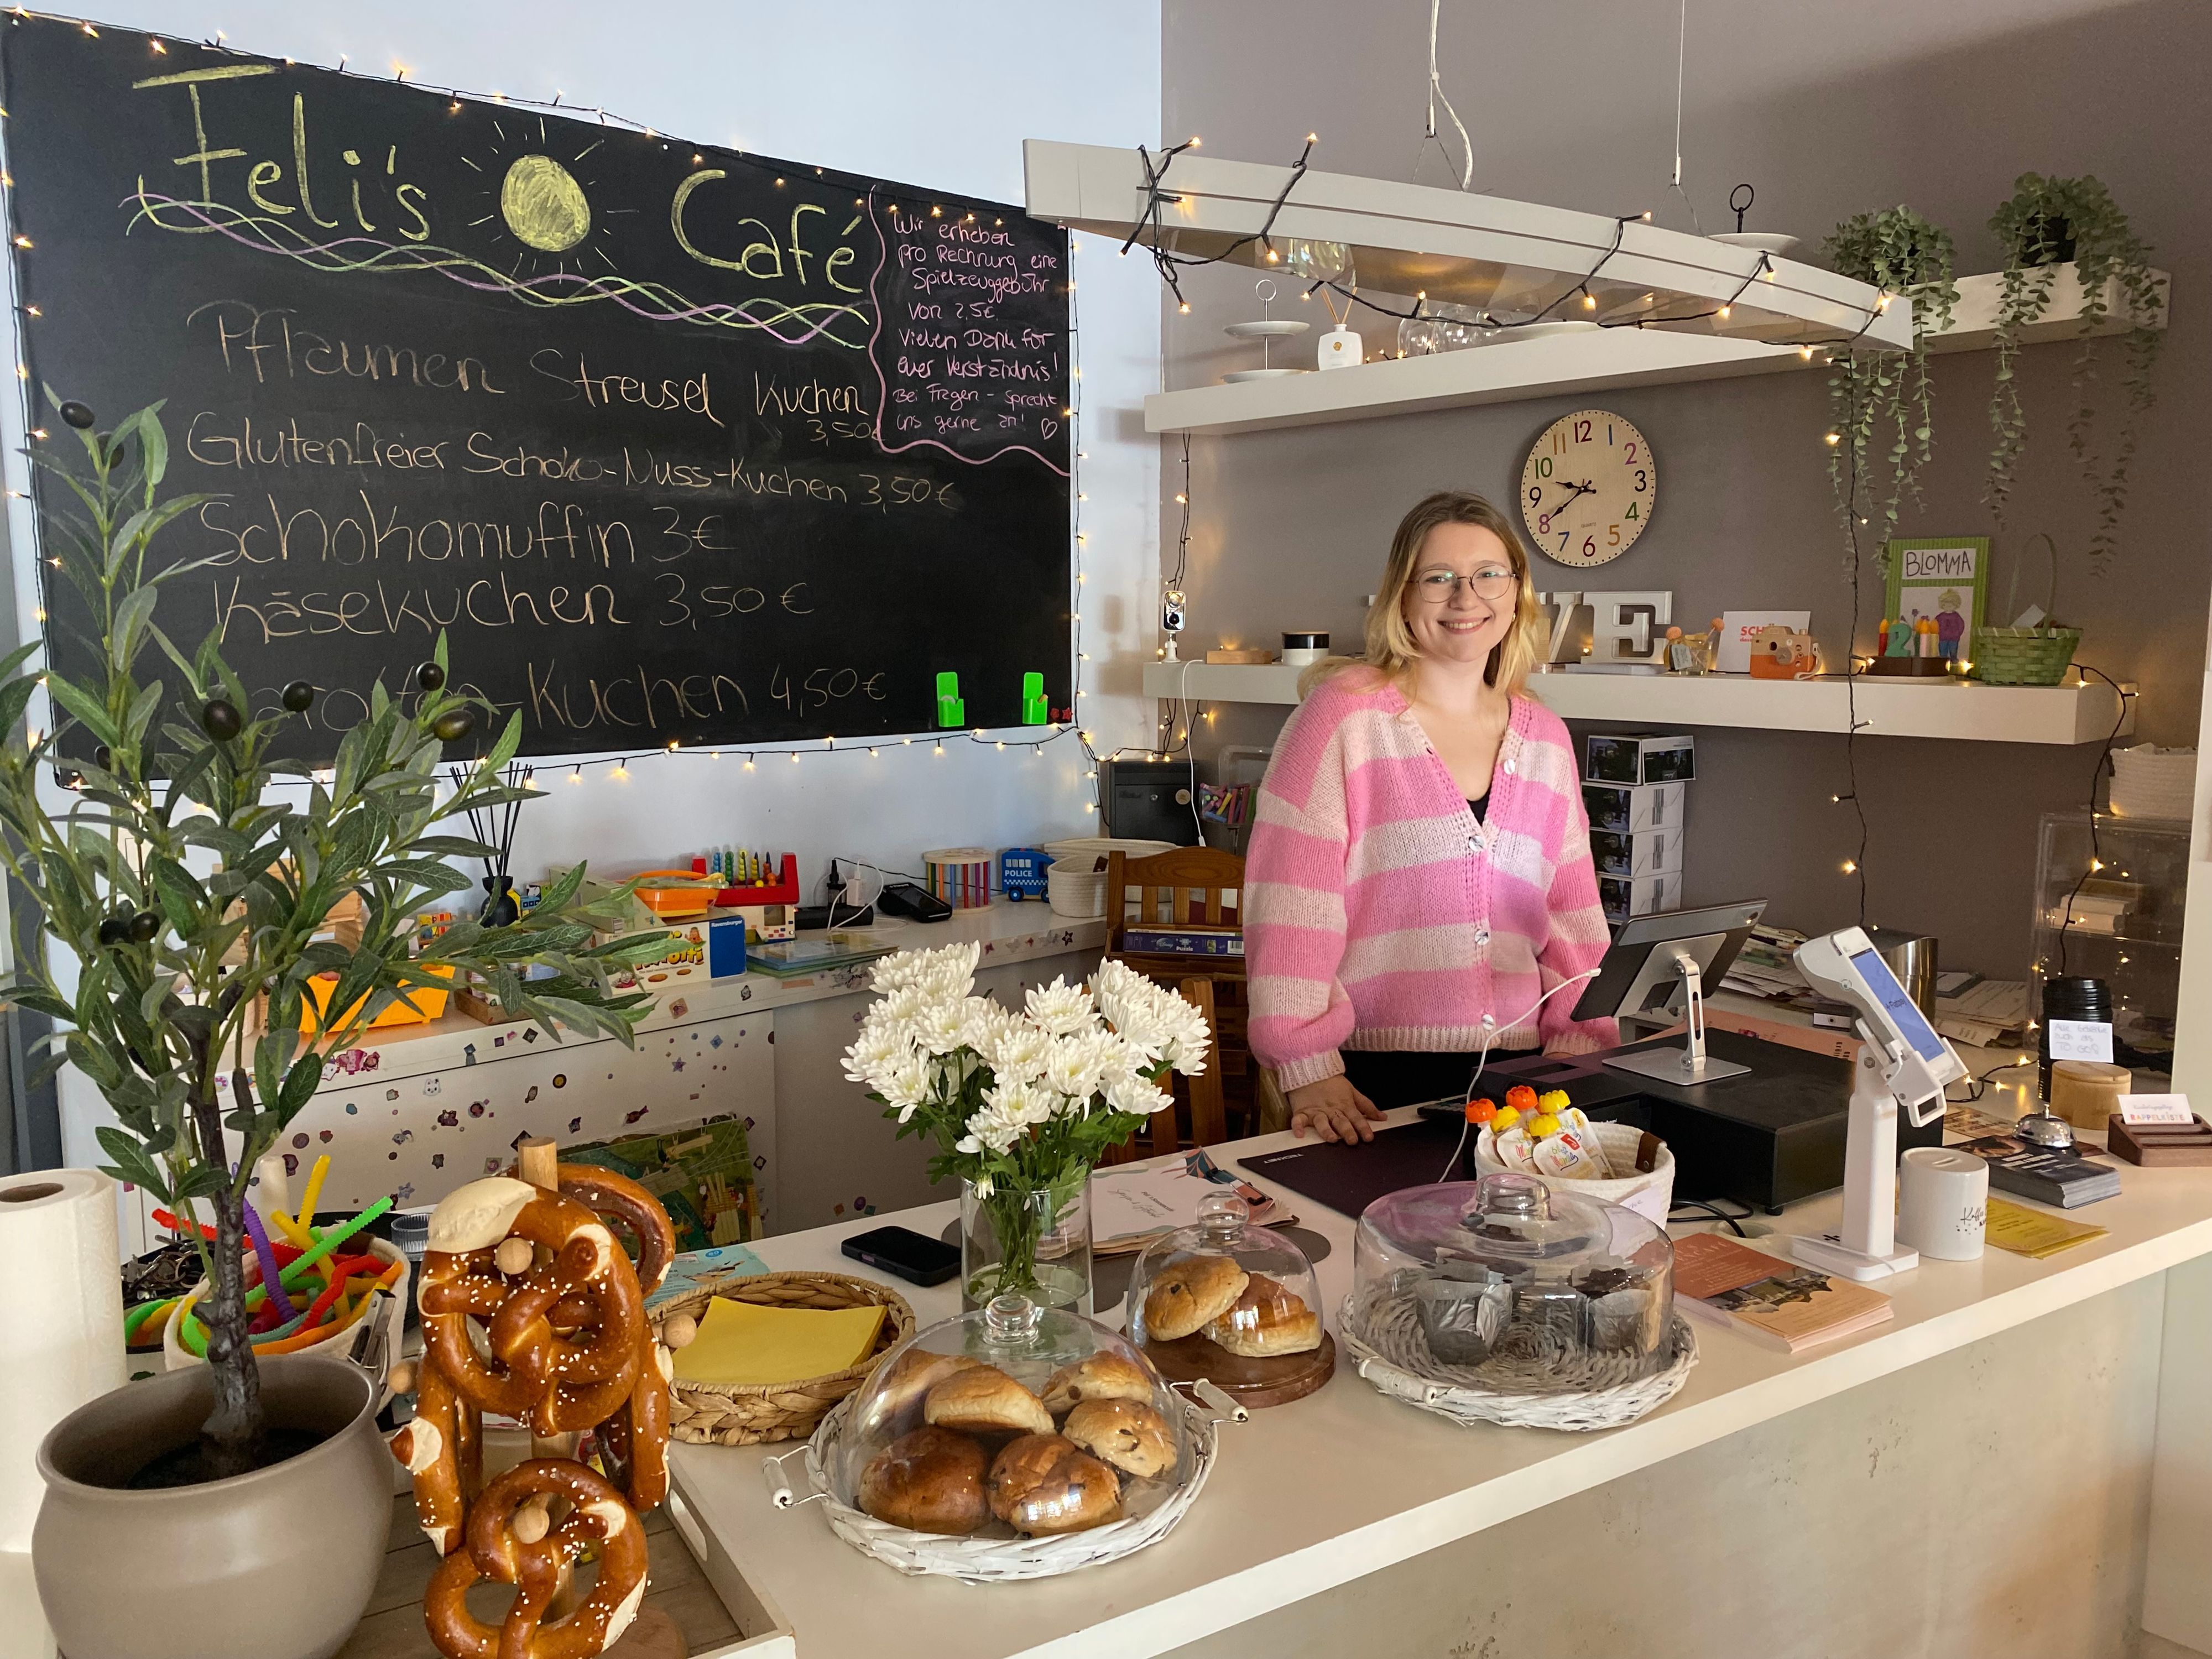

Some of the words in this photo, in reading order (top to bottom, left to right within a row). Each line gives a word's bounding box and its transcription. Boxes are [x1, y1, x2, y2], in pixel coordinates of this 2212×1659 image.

[133, 64, 430, 241] Feli's
[671, 169, 863, 294] Café
[894, 213, 924, 234] Wir
[938, 220, 1015, 247] erheben
[936, 244, 1018, 279] Rechnung
[1030, 254, 1057, 269] eine
[899, 328, 957, 351] Vielen
[963, 328, 1017, 351] Dank
[186, 299, 506, 394] Pflaumen
[529, 348, 726, 428] Streusel
[755, 369, 869, 418] Kuchen
[893, 388, 918, 403] Bei
[926, 383, 980, 411] Fragen
[935, 415, 982, 434] gerne
[1574, 420, 1592, 444] 12
[1608, 424, 1613, 446] 1
[1553, 432, 1566, 456] 11
[1624, 442, 1637, 465] 2
[186, 411, 451, 480] Glutenfreier
[859, 473, 958, 514] 3,50€
[1535, 457, 1553, 479] 10
[1634, 470, 1647, 492] 3
[1529, 487, 1542, 508] 9
[1625, 502, 1640, 521] 4
[200, 489, 637, 569] Schokomuffin
[1538, 514, 1551, 534] 8
[1607, 524, 1620, 546] 5
[1558, 531, 1570, 552] 7
[1583, 535, 1596, 557] 6
[1905, 550, 1973, 577] BLOMMA
[214, 571, 630, 646] Käsekuchen
[1740, 626, 1765, 636] SCH
[770, 664, 886, 718] 4,50€
[1004, 869, 1033, 878] POLICE
[711, 919, 743, 928] Ravensburger
